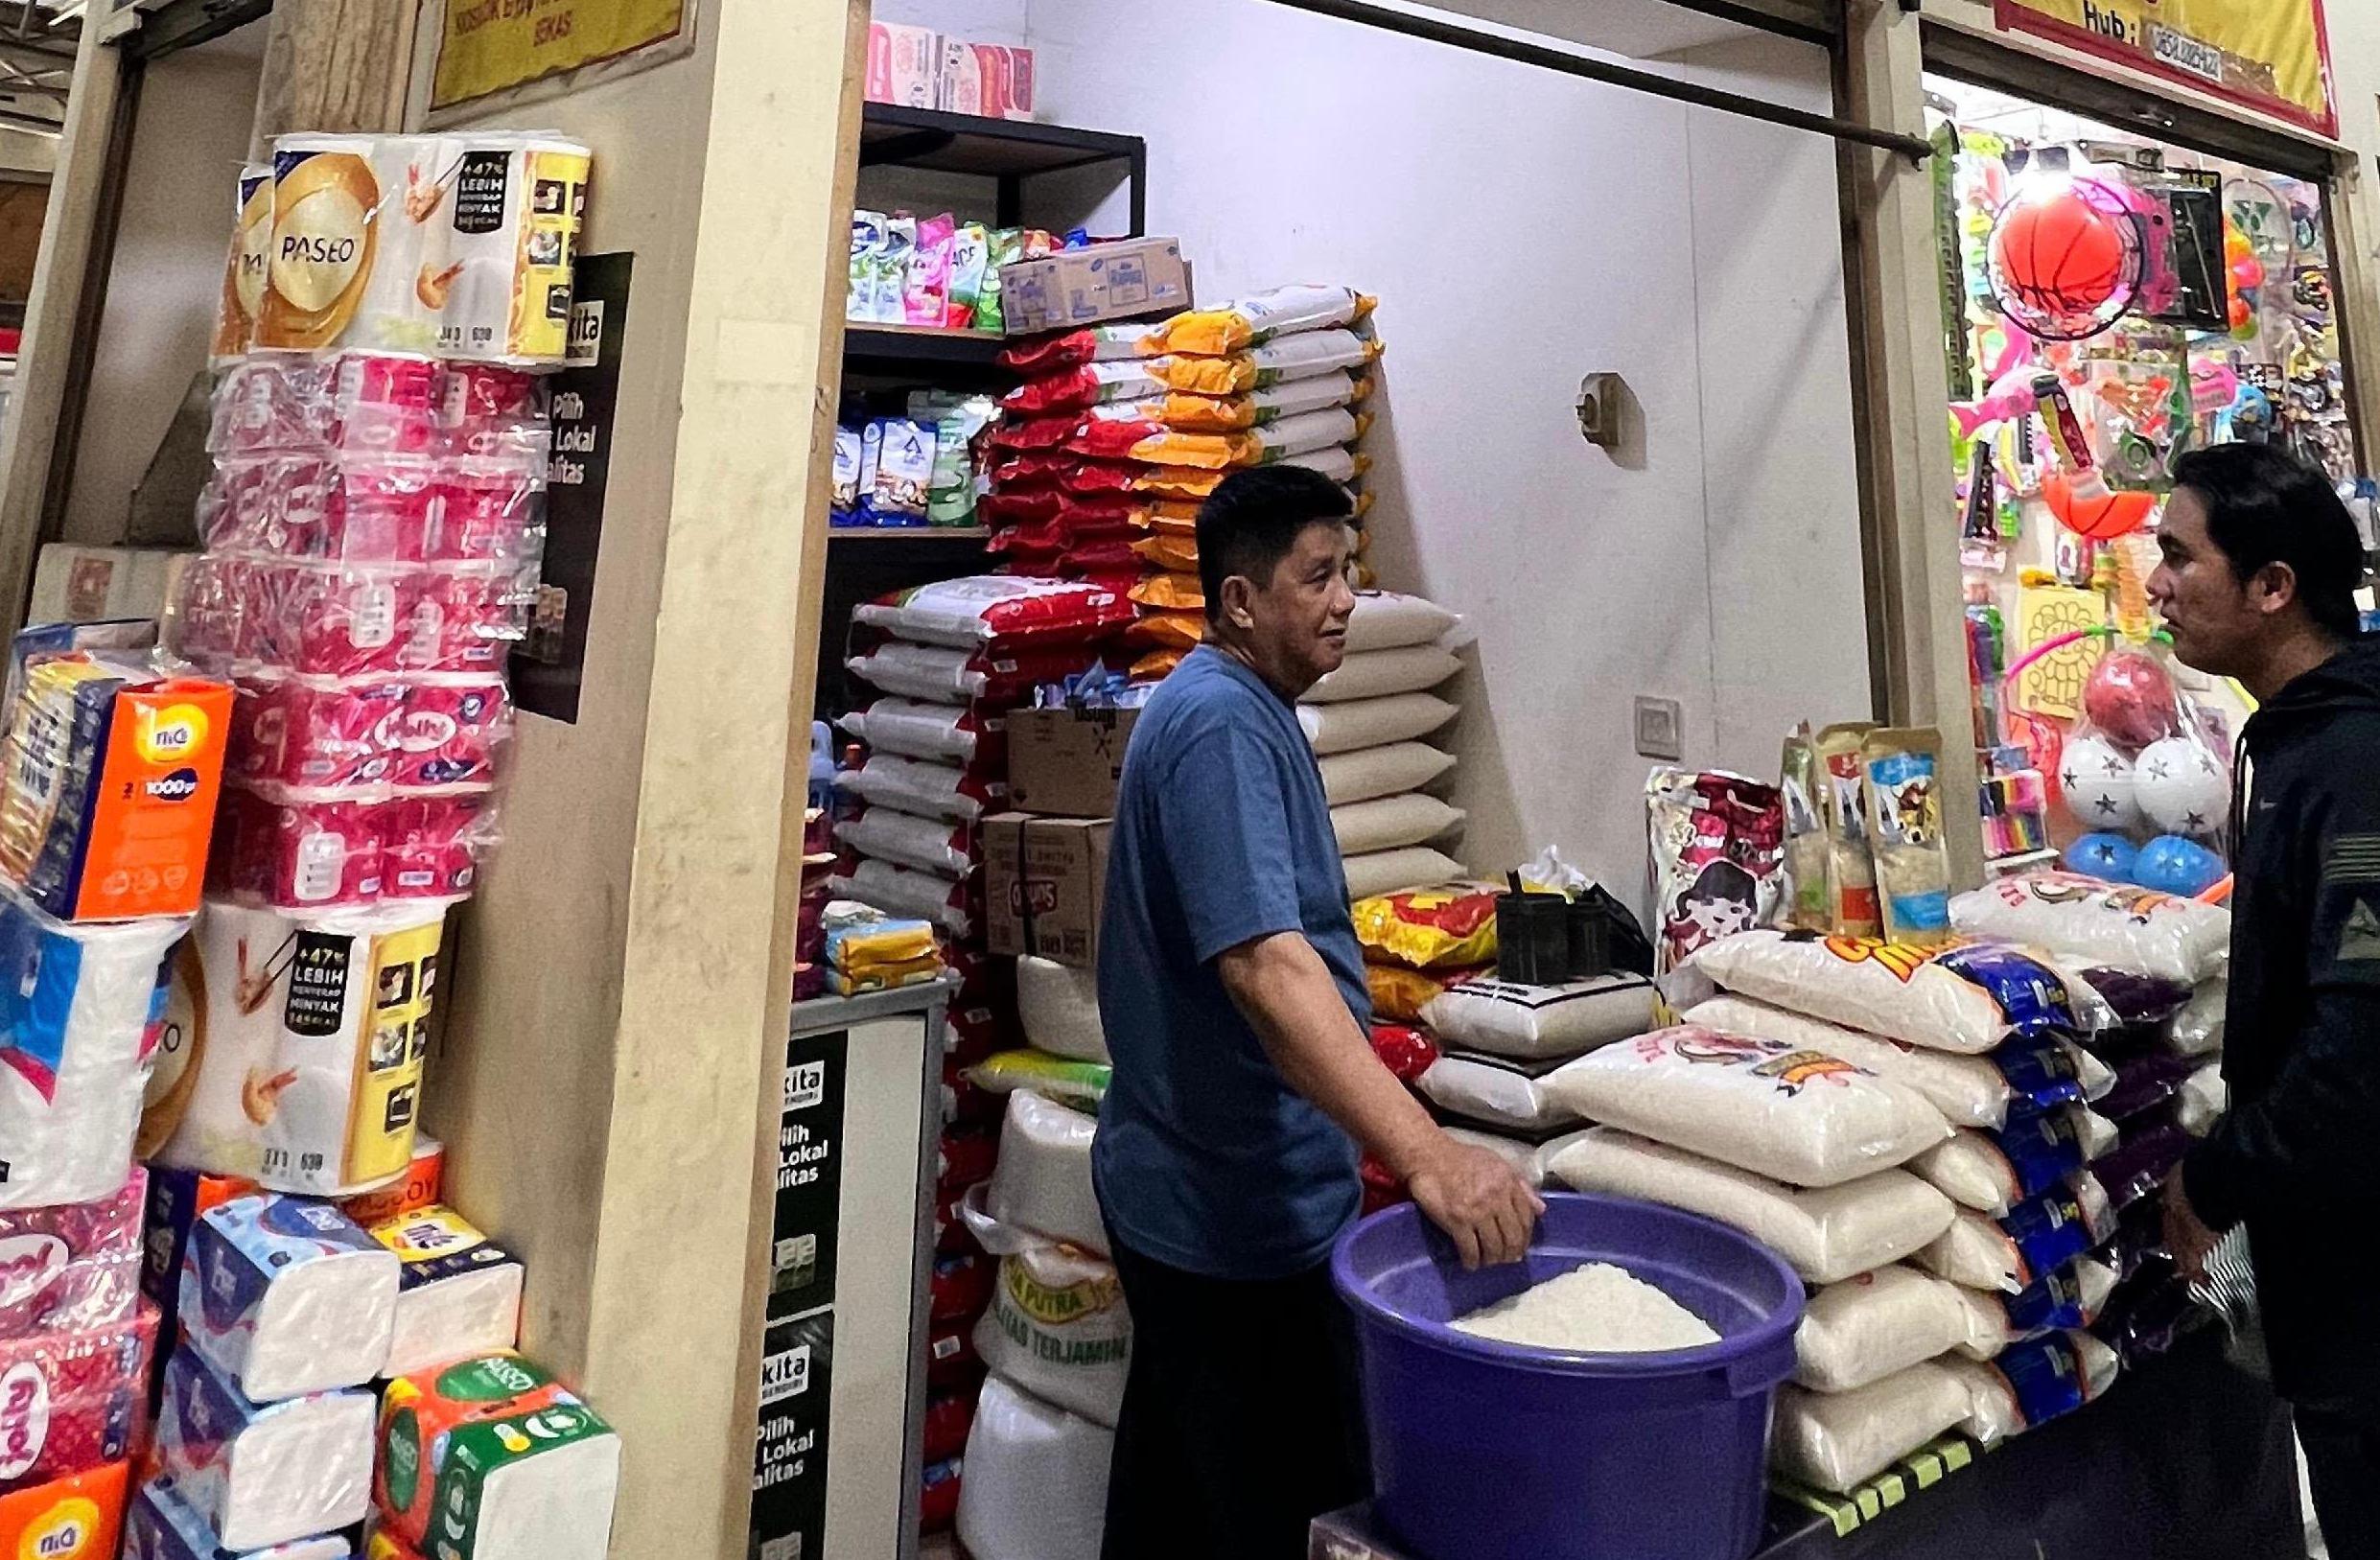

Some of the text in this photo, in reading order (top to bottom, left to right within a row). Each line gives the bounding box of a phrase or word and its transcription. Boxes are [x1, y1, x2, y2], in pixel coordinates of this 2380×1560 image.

[280, 236, 355, 263] PASEO
[293, 966, 345, 986] LEBIH
[762, 1429, 814, 1465] Lokal
